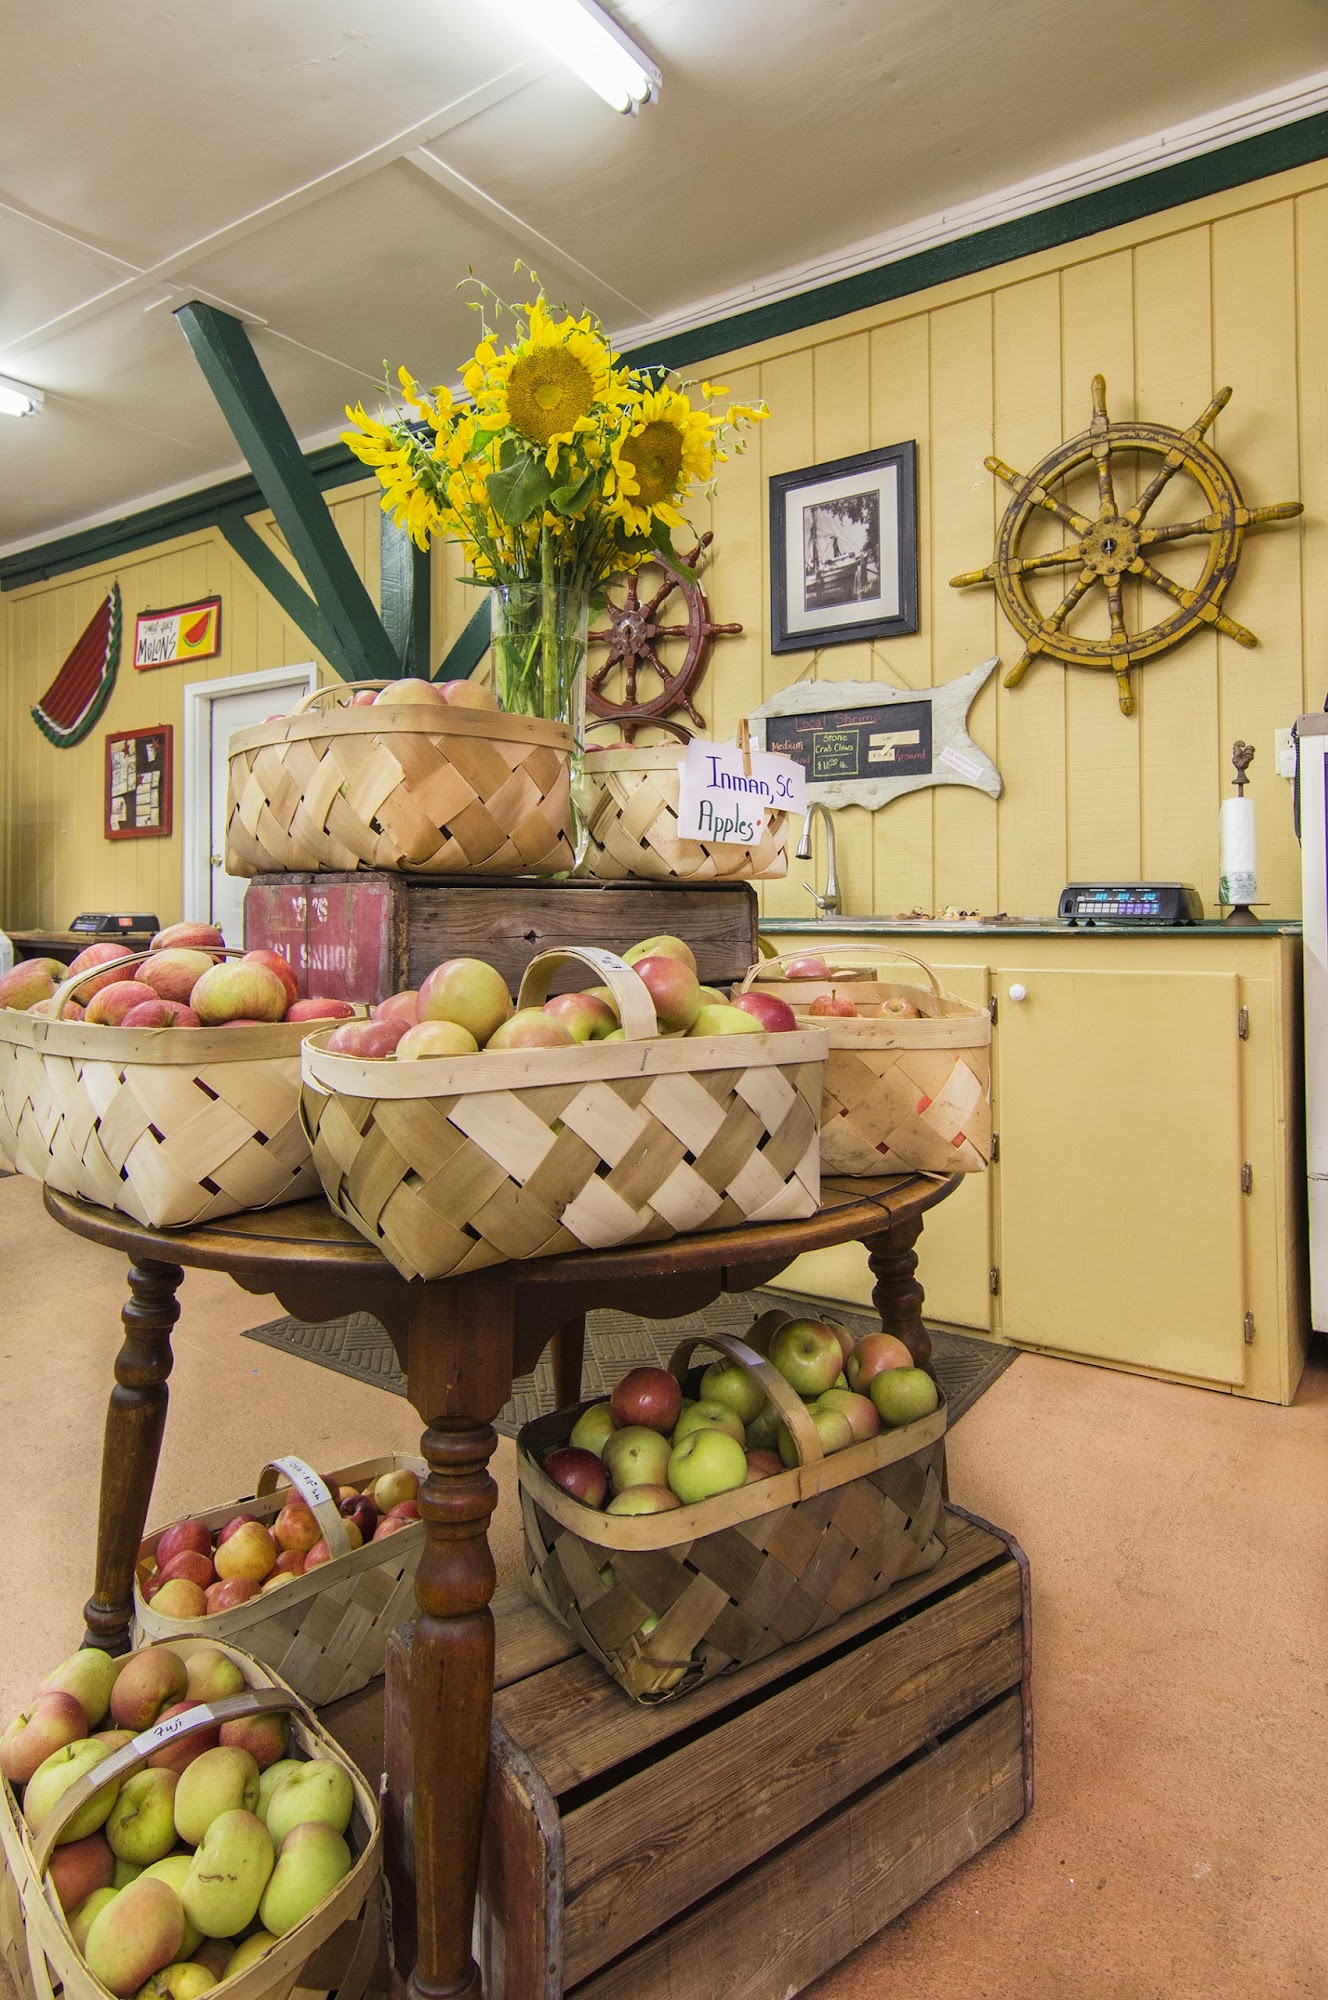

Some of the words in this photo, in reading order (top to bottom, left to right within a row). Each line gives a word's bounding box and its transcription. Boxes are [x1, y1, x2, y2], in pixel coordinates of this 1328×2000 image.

[795, 715, 826, 730] Local
[771, 740, 804, 752] Medium
[776, 774, 795, 799] SC
[698, 799, 754, 843] Apples
